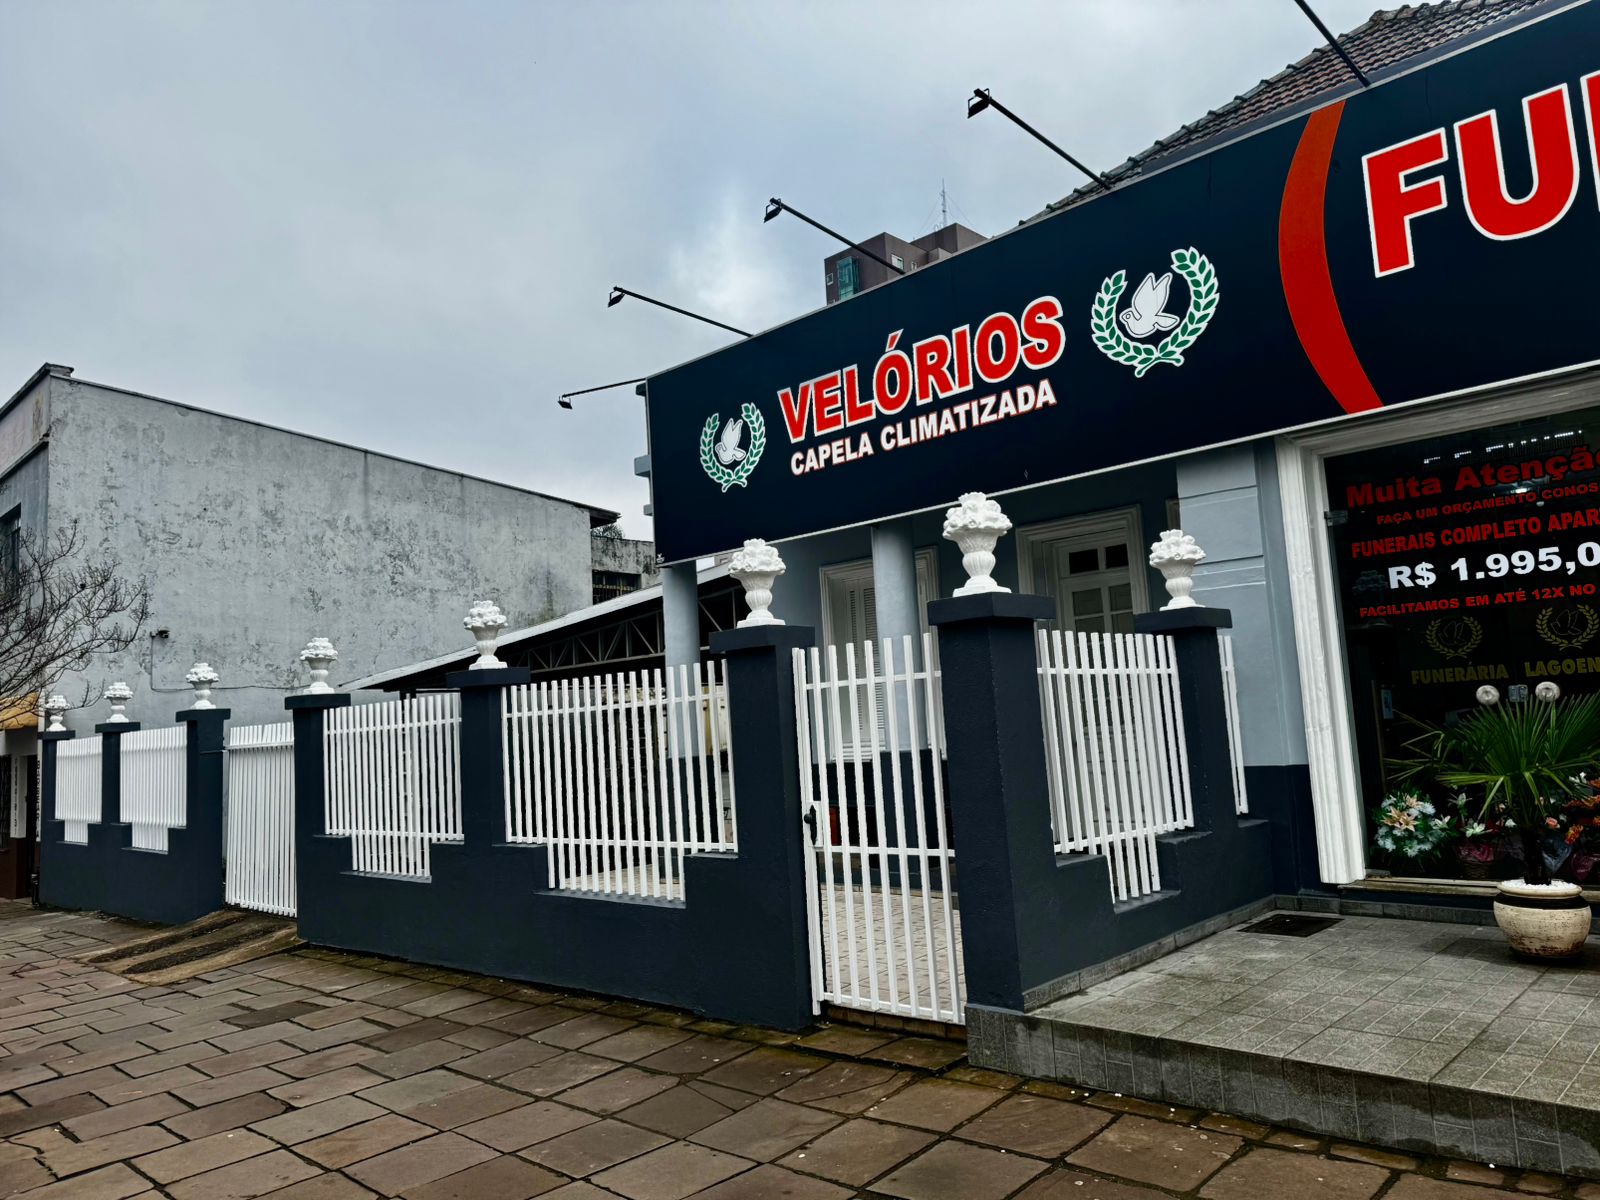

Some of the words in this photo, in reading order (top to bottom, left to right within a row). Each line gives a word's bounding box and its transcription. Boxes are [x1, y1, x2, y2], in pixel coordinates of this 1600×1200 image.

[1362, 71, 1600, 278] FU
[777, 296, 1066, 444] VELÓRIOS
[790, 436, 874, 476] CAPELA
[881, 378, 1057, 452] CLIMATIZADA
[1346, 474, 1442, 508] Muita
[1455, 447, 1600, 491] Atençã
[1351, 531, 1436, 558] FUNERAIS
[1441, 517, 1541, 546] COMPLETO
[1548, 508, 1600, 532] APAR
[1377, 510, 1411, 525] FAÇA
[1416, 507, 1438, 519] UM
[1442, 491, 1537, 515] ORÇAMENTO
[1360, 597, 1460, 618] FACILITAMOS
[1466, 595, 1490, 607] EM
[1495, 588, 1526, 604] ATÉ
[1532, 586, 1564, 600] 12X
[1569, 583, 1596, 596] NO
[1388, 562, 1437, 589] R$
[1411, 661, 1509, 684] FUNERÁRIA
